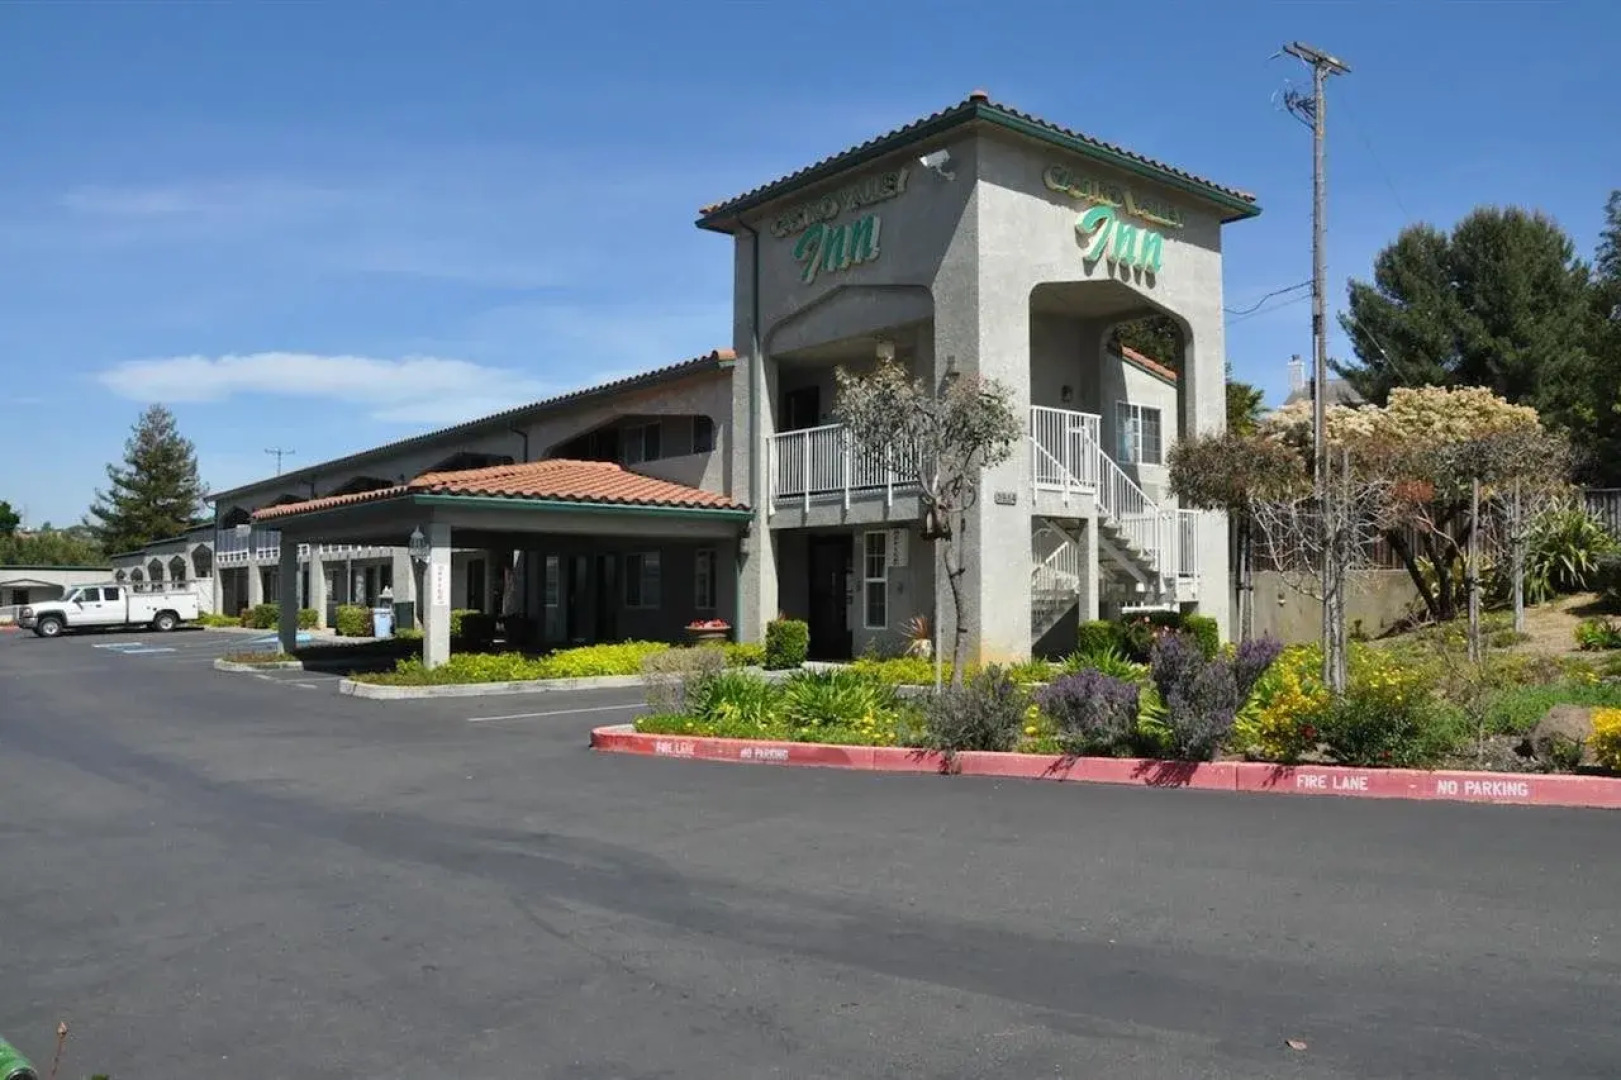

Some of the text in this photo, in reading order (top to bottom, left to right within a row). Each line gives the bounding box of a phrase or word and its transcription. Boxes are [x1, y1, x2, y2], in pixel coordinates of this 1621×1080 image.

[793, 211, 881, 285] Inn
[1074, 203, 1164, 273] Inn
[1296, 773, 1529, 797] FIRE LANE NO PARKING
